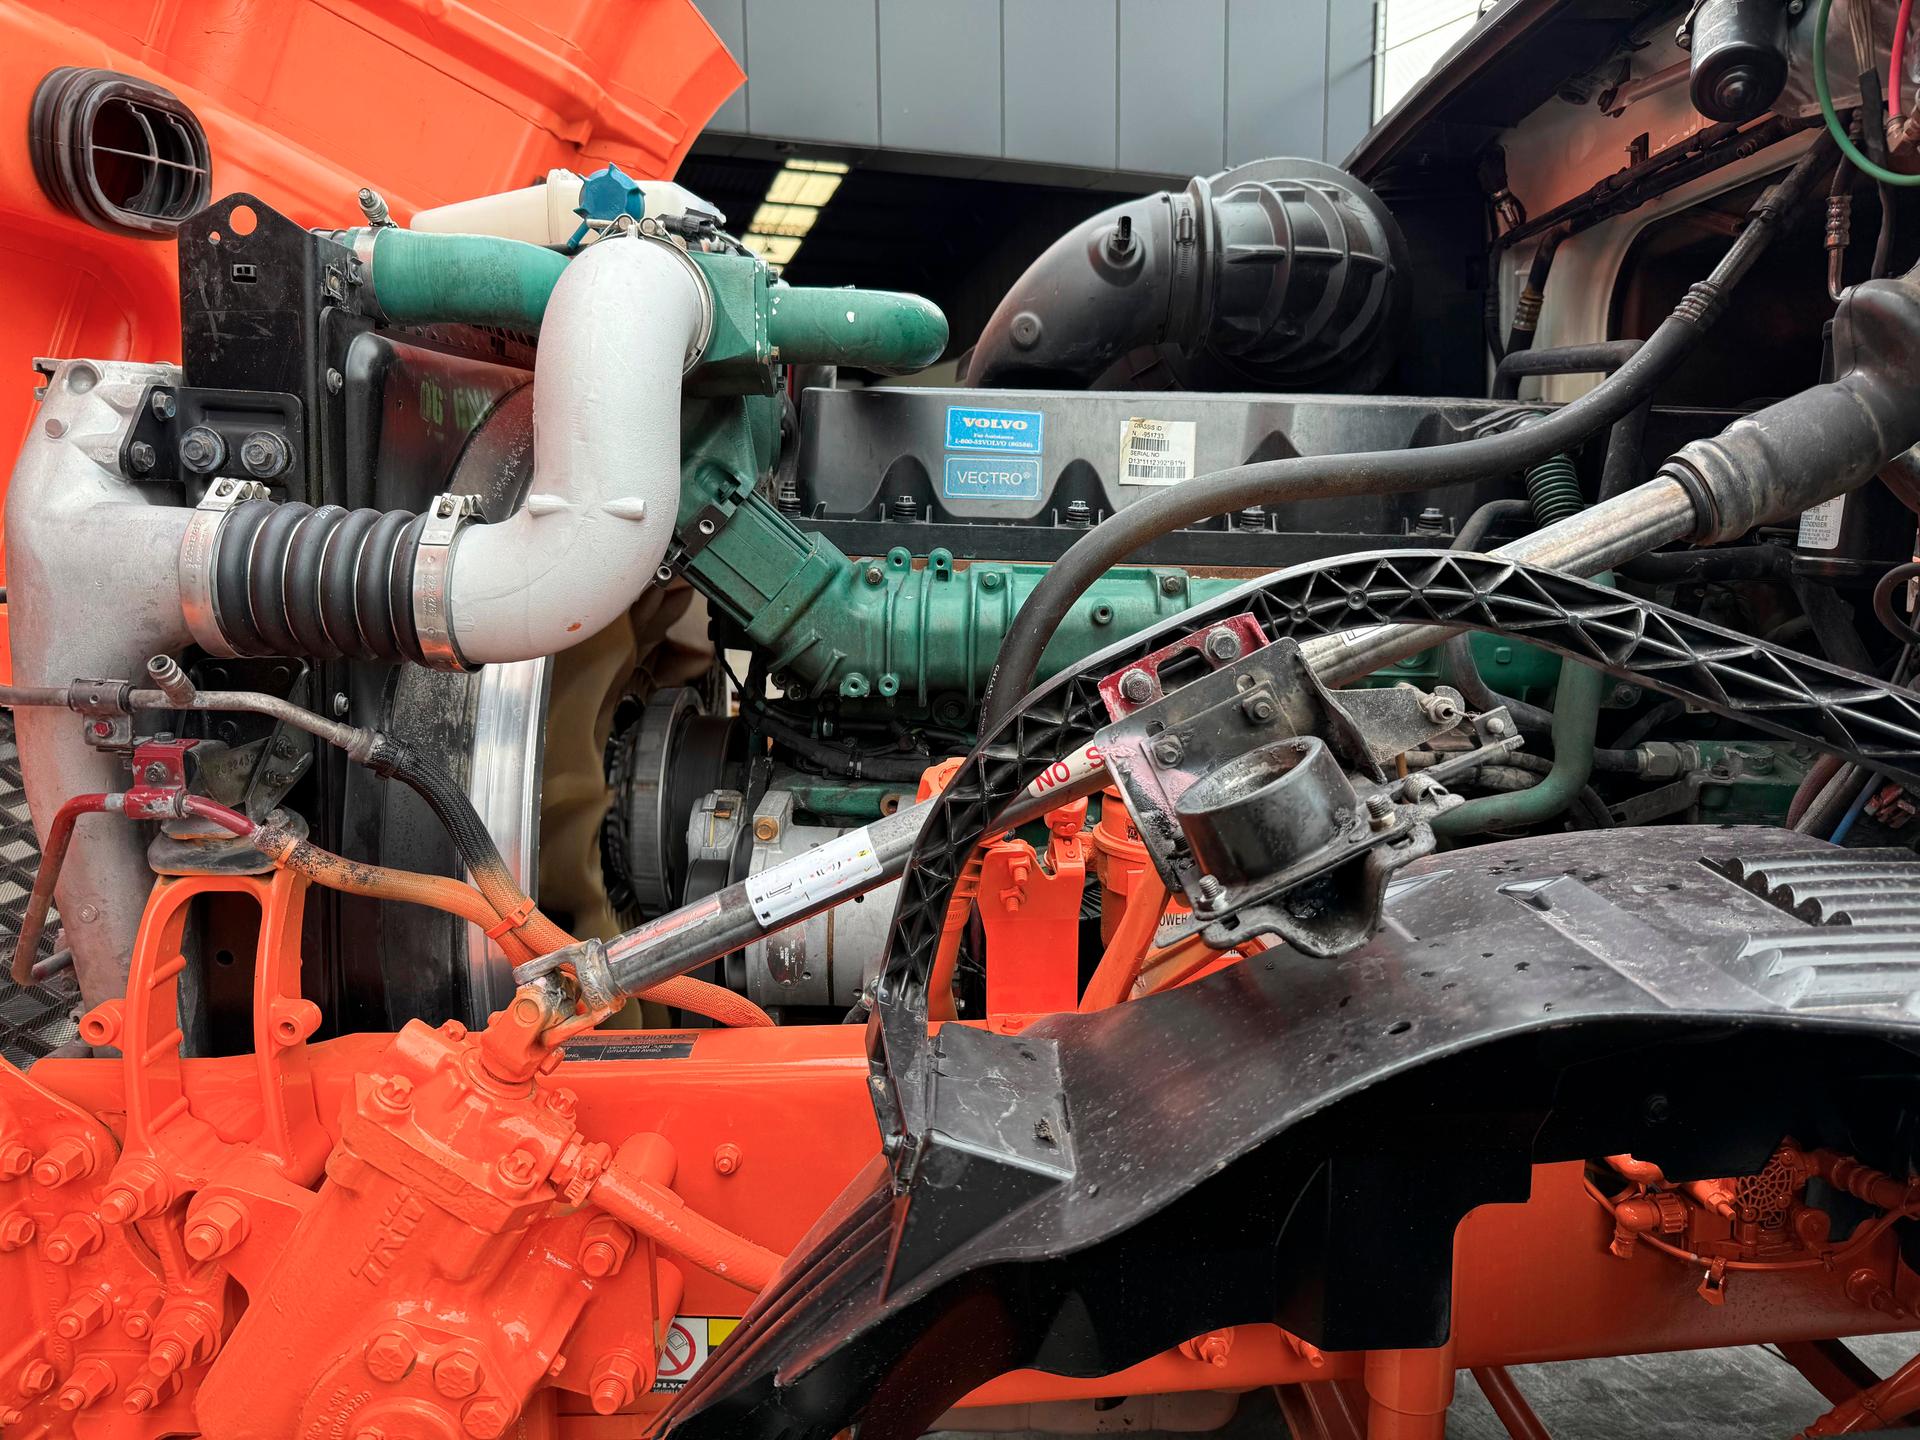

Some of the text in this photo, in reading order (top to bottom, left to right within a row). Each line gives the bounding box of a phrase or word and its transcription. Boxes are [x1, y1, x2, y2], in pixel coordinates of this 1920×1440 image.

[963, 417, 1028, 430] VOLVO
[1035, 746, 1106, 792] NO S
[1160, 913, 1188, 926] OWER
[348, 1192, 425, 1288] TRW
